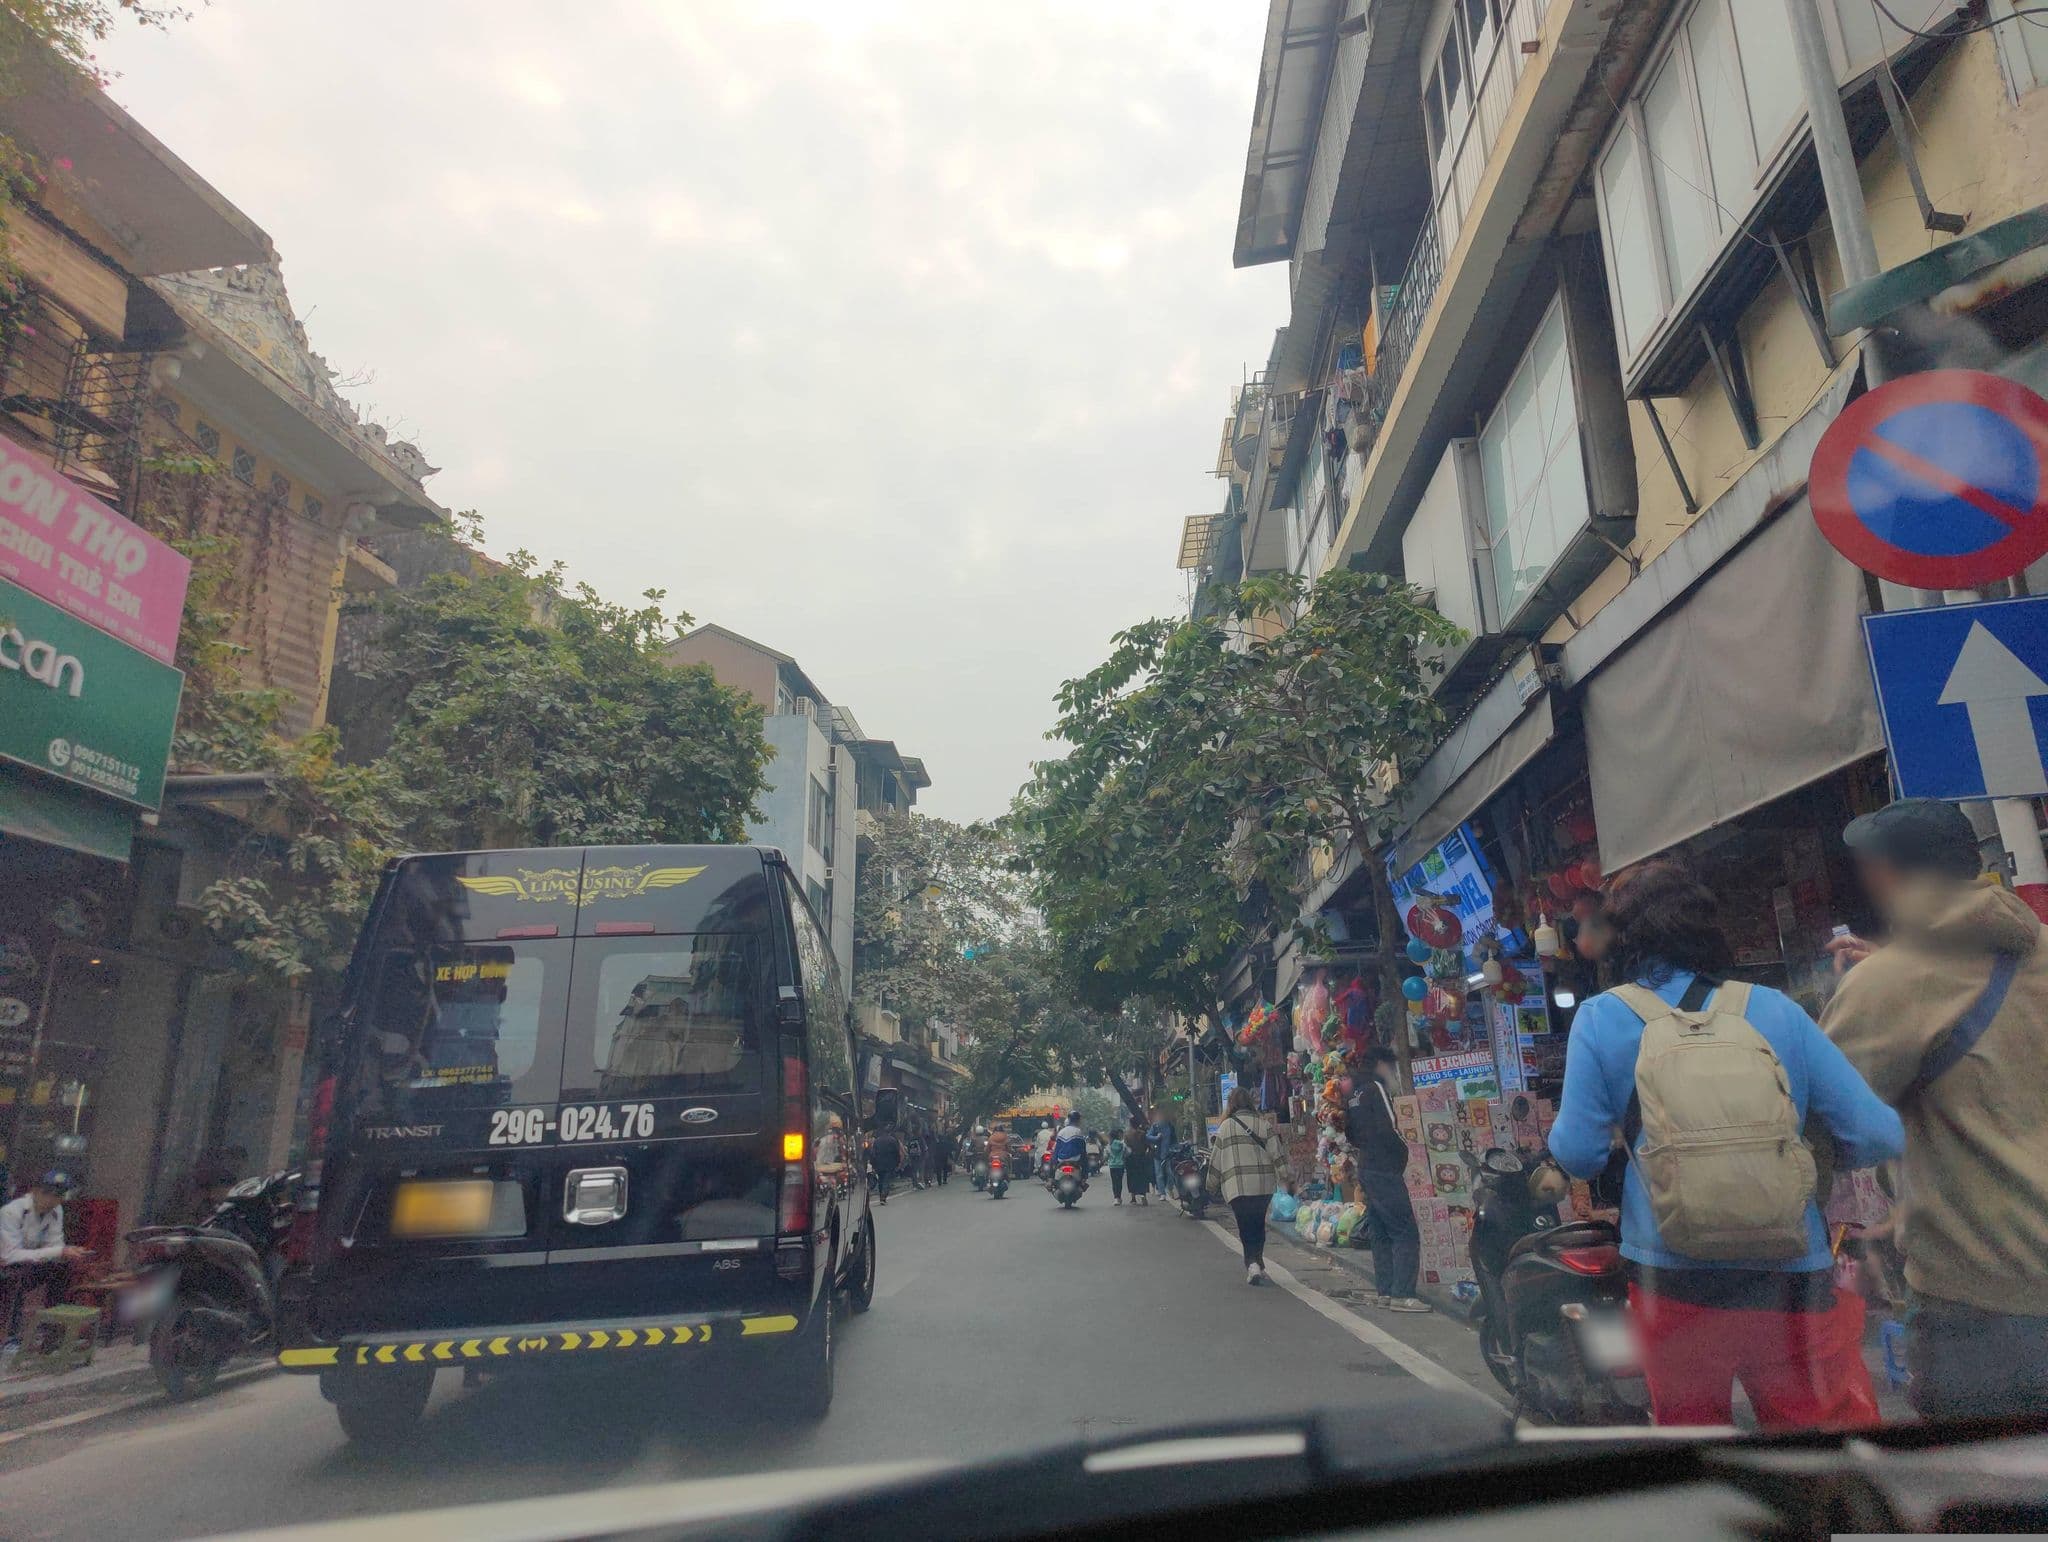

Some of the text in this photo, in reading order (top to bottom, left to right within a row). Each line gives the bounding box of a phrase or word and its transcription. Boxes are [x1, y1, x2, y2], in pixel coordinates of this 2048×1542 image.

[68, 503, 148, 582] THỌ
[106, 581, 142, 620] EM
[530, 876, 635, 893] LIMOUSINE
[436, 966, 451, 981] XE
[1440, 1051, 1493, 1070] EXCHANGE
[1421, 1072, 1441, 1083] CARD
[1460, 1064, 1494, 1077] LAUNDRY
[364, 1124, 445, 1139] TRANSIT
[489, 1104, 654, 1144] 29G-024.76
[712, 1258, 741, 1270] ABS
